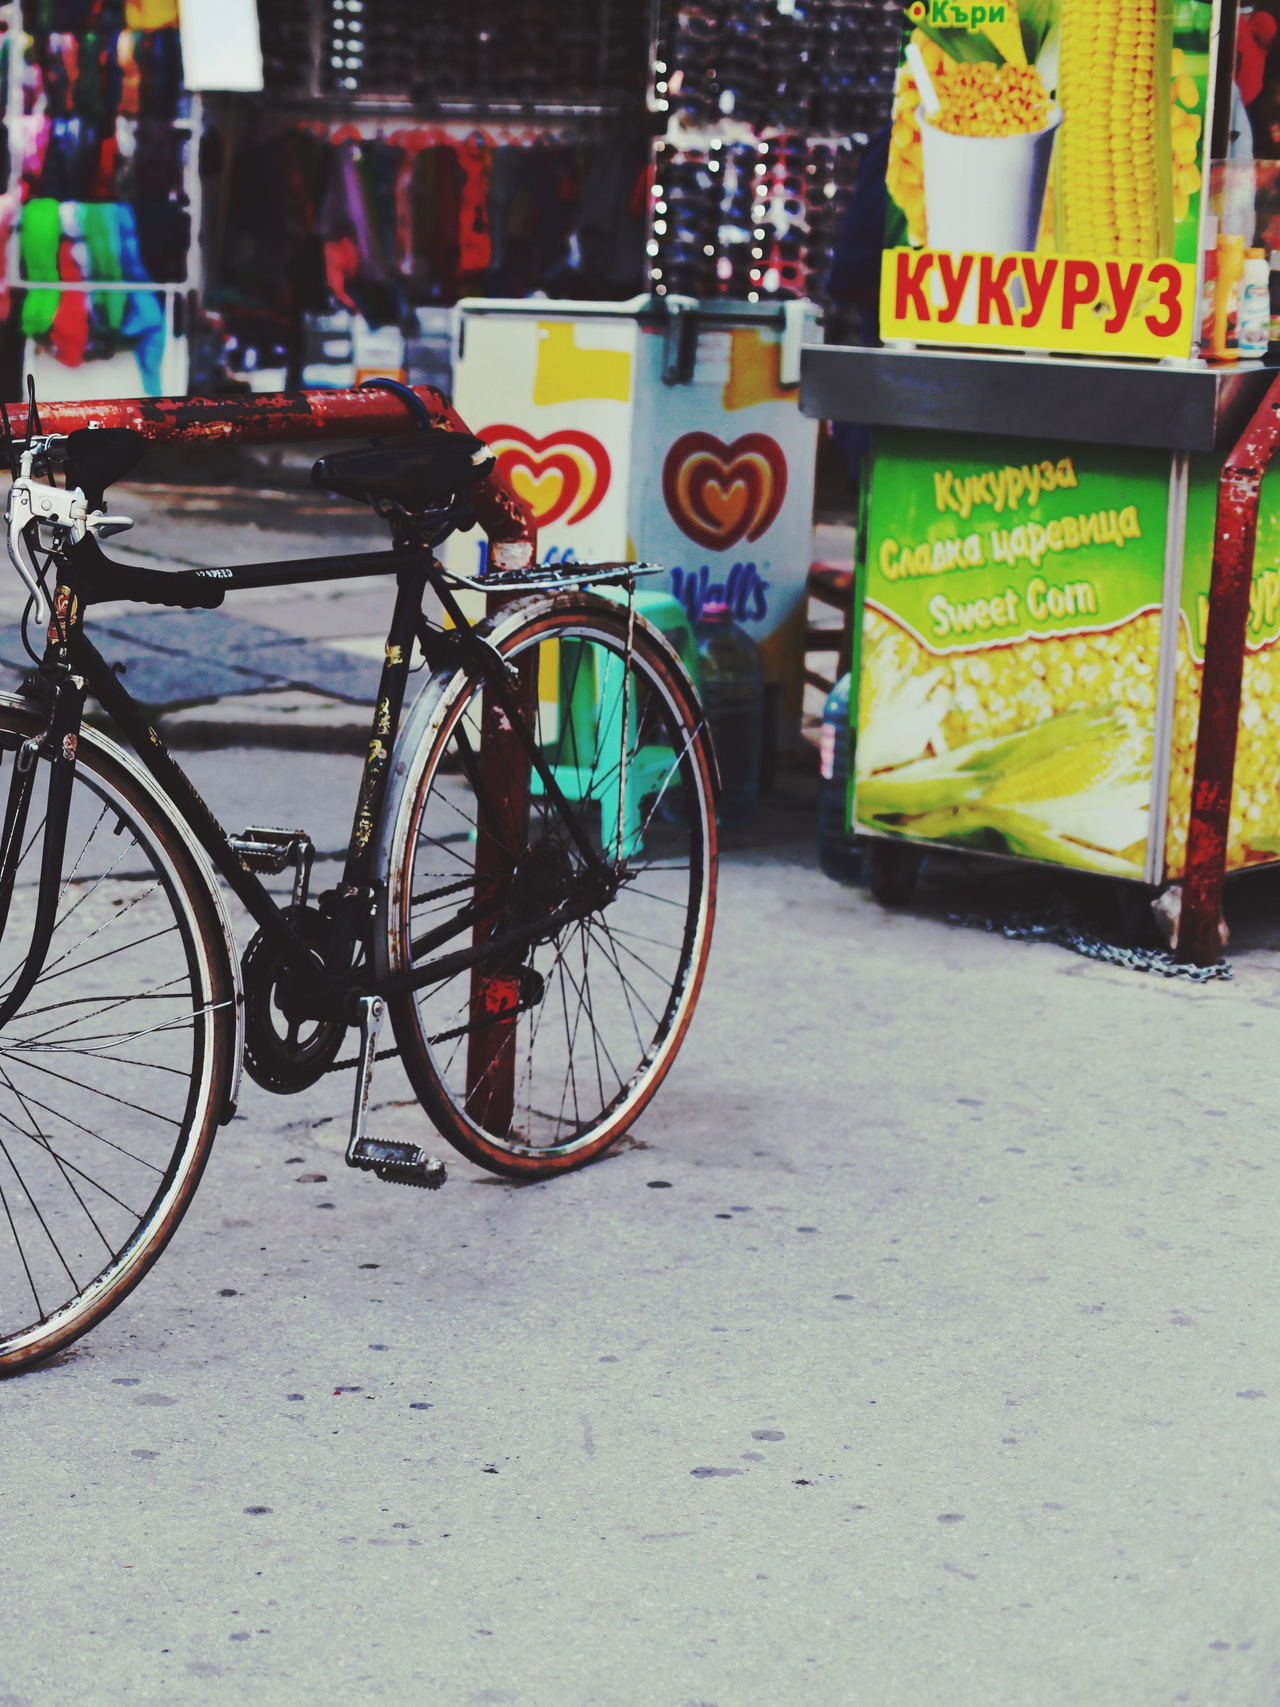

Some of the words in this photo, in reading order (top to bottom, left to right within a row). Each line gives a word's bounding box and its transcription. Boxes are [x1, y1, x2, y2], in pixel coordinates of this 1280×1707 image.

[932, 0, 1005, 29] Къри
[894, 253, 1183, 338] КУКУРУЗ
[933, 457, 1078, 520] Кукуруза
[879, 533, 985, 581] Сладка
[991, 505, 1142, 568] царевица
[928, 588, 1020, 636] Sweet
[1026, 577, 1098, 622] Corn
